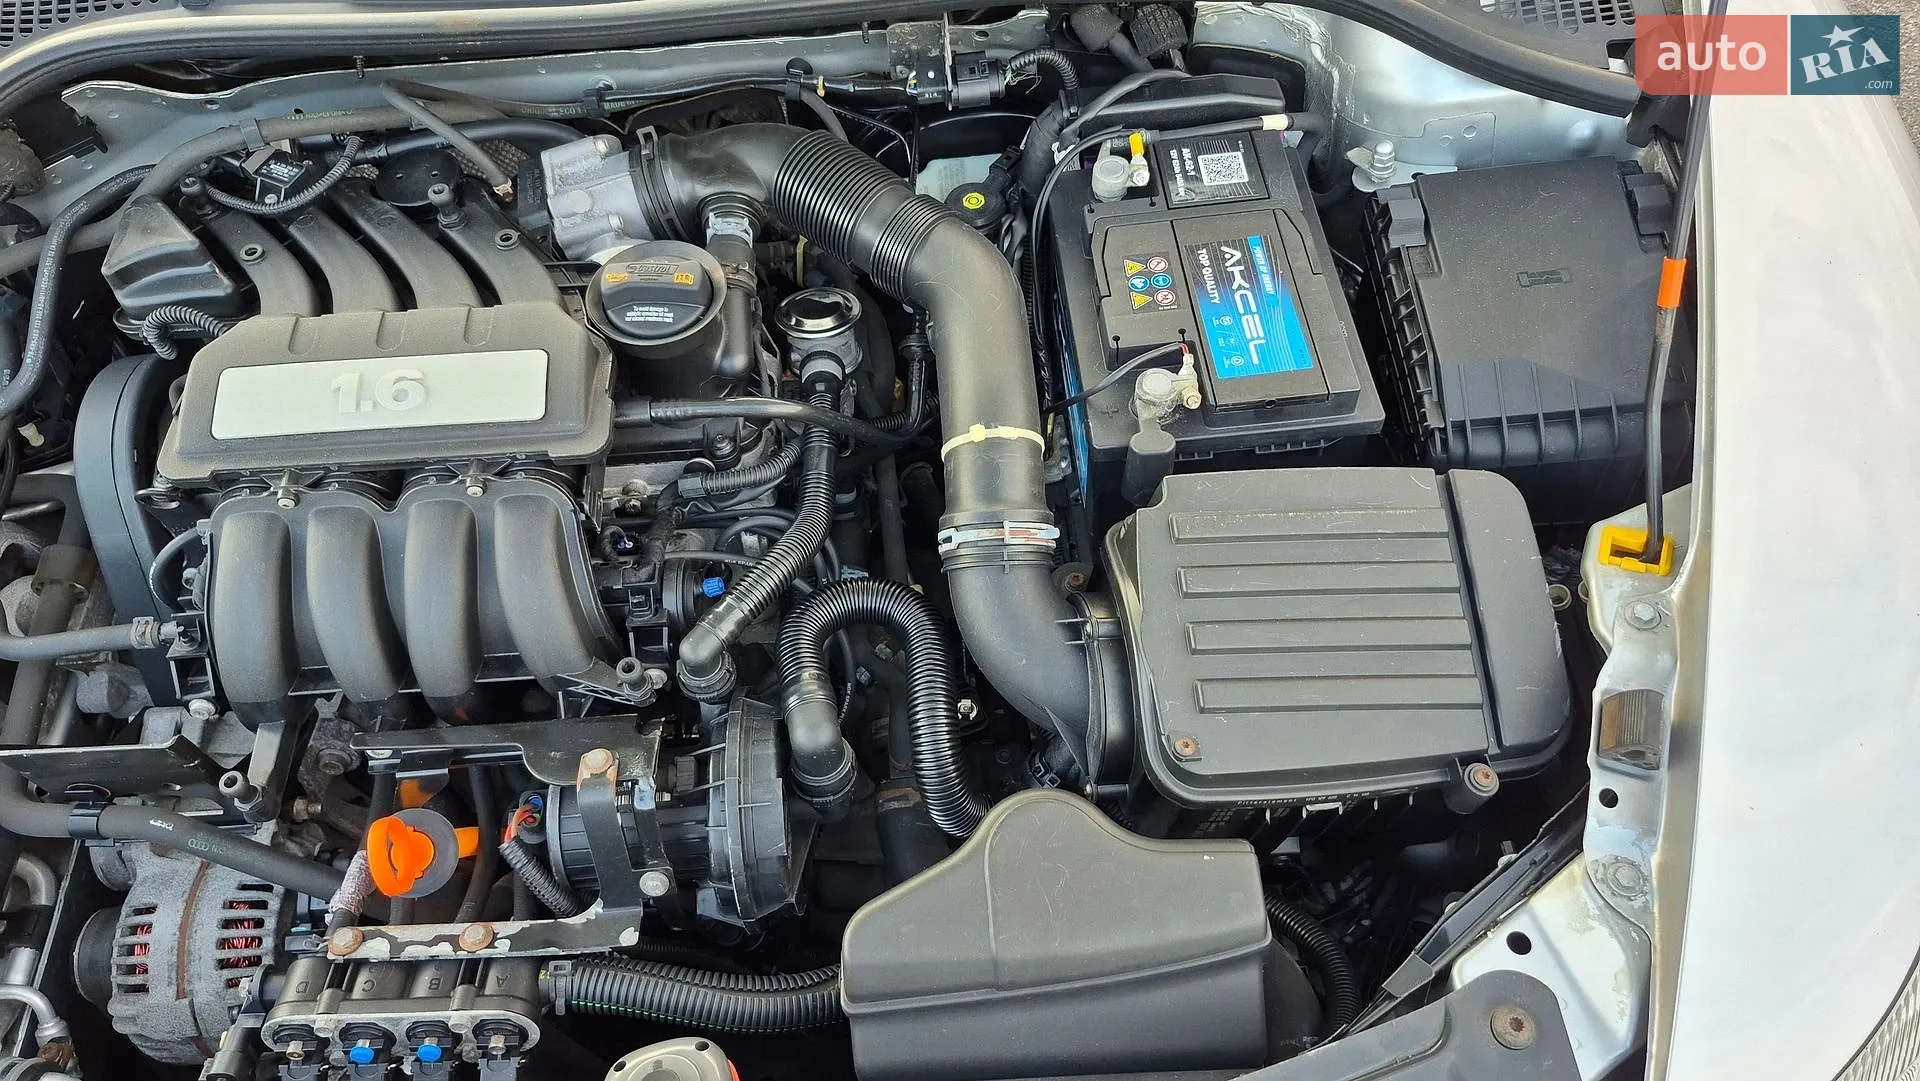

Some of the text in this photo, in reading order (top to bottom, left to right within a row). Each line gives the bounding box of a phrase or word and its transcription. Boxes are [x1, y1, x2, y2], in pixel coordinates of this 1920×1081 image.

[1198, 248, 1210, 268] TOP
[1202, 267, 1220, 304] QUALITY
[1220, 246, 1266, 365] AKCEL
[331, 369, 426, 414] 1.6
